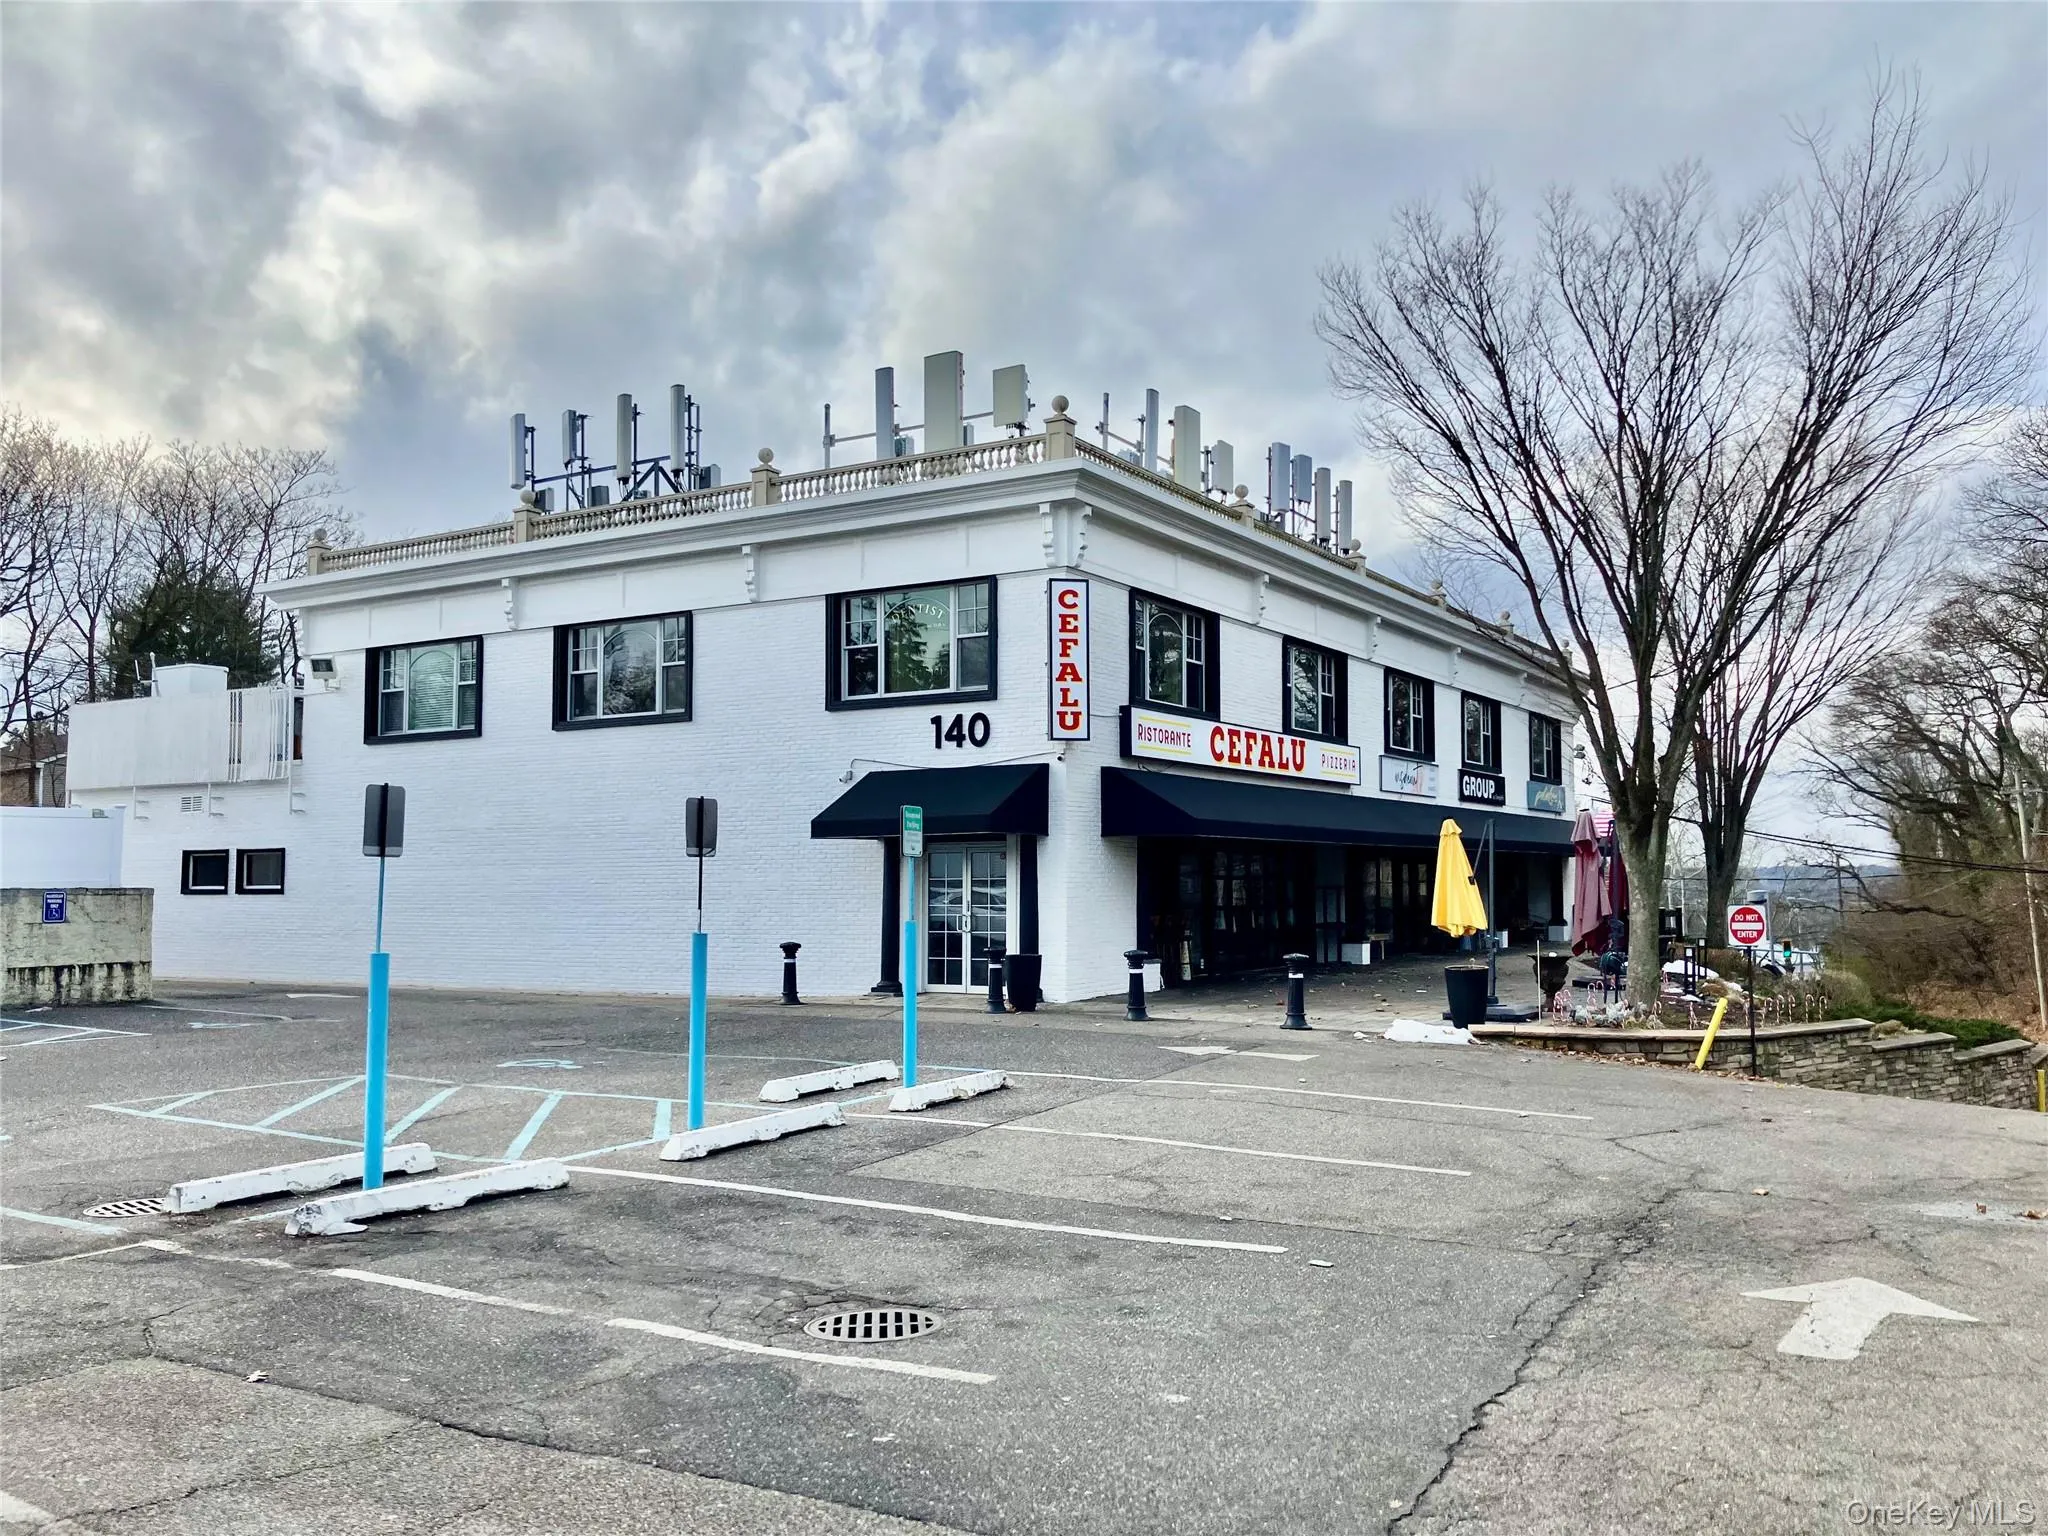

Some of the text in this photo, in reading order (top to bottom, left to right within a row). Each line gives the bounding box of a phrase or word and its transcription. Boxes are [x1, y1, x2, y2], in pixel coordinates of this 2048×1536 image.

[1056, 589, 1083, 732] CEFALU
[930, 712, 991, 749] 140
[1137, 723, 1357, 772] RISTORANTE CEFALU PIZZERIA
[1462, 775, 1496, 799] GROUP
[1737, 930, 1758, 938] ENTER
